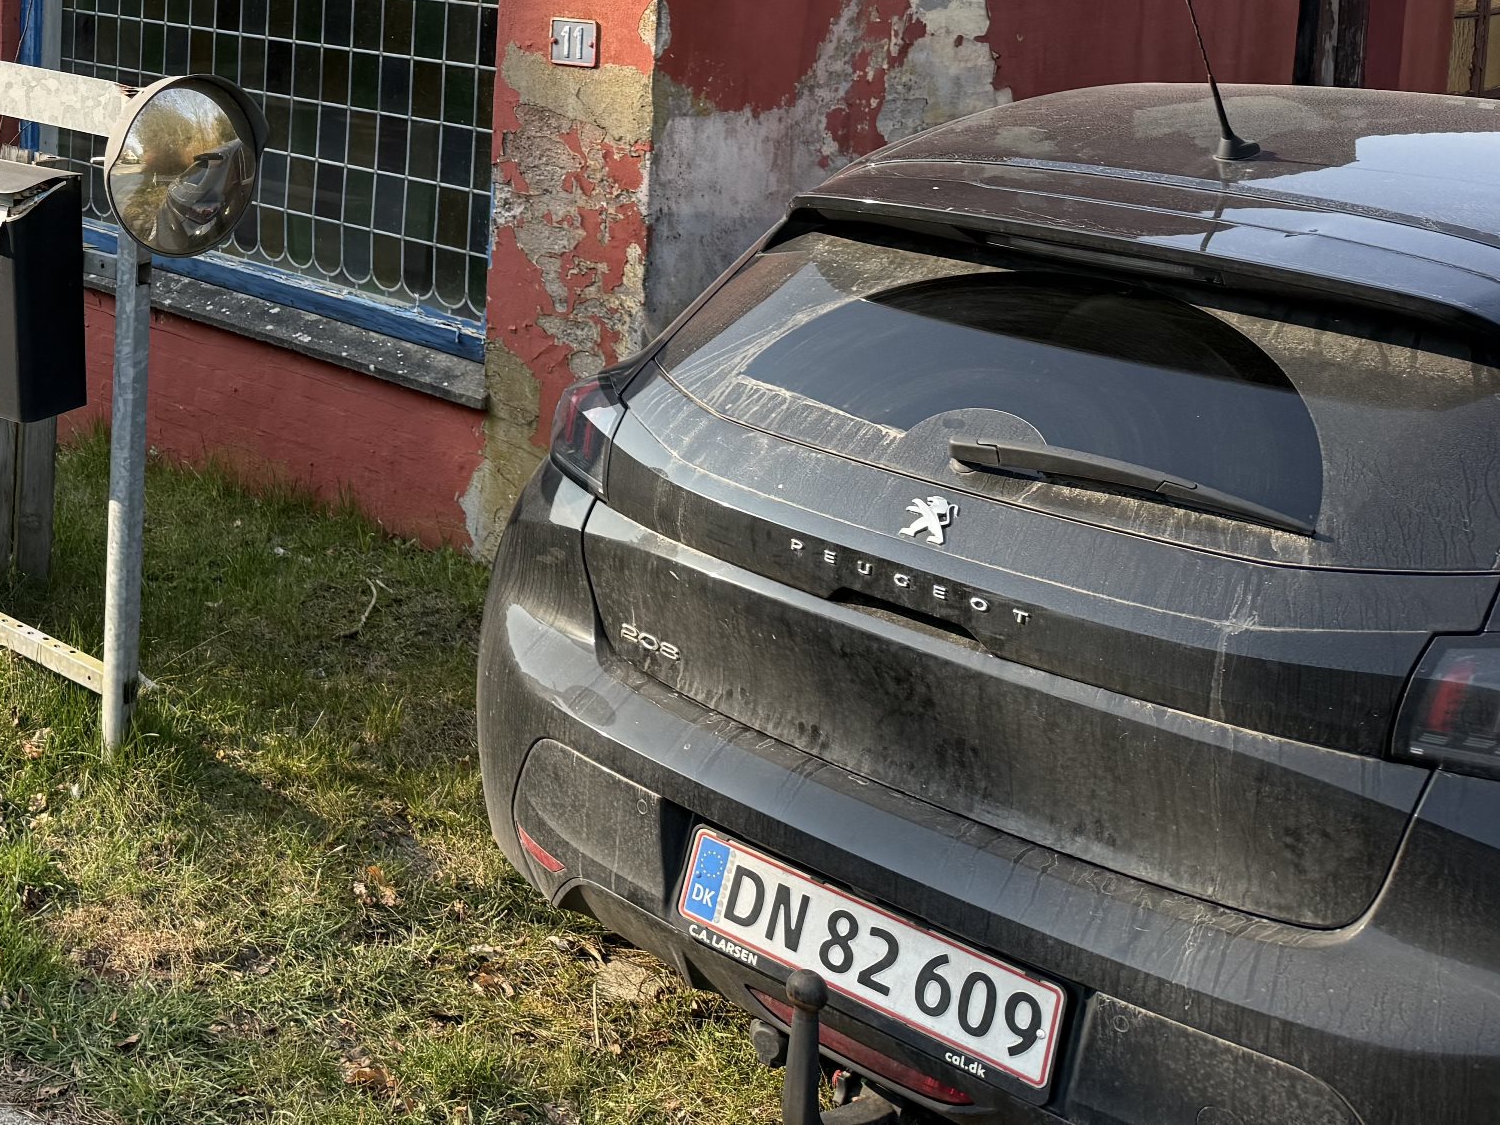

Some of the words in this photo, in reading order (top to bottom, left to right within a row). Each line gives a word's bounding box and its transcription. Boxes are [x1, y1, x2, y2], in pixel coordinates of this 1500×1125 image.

[561, 26, 583, 59] 11
[790, 537, 1031, 625] PEUGEOT
[620, 622, 681, 661] 208
[692, 883, 715, 907] DK
[689, 924, 710, 944] C.A.
[711, 934, 758, 966] LARSEN
[723, 864, 810, 953] DN
[819, 909, 900, 996] 82
[914, 953, 1043, 1057] 609
[944, 1050, 986, 1078] cal.dk
